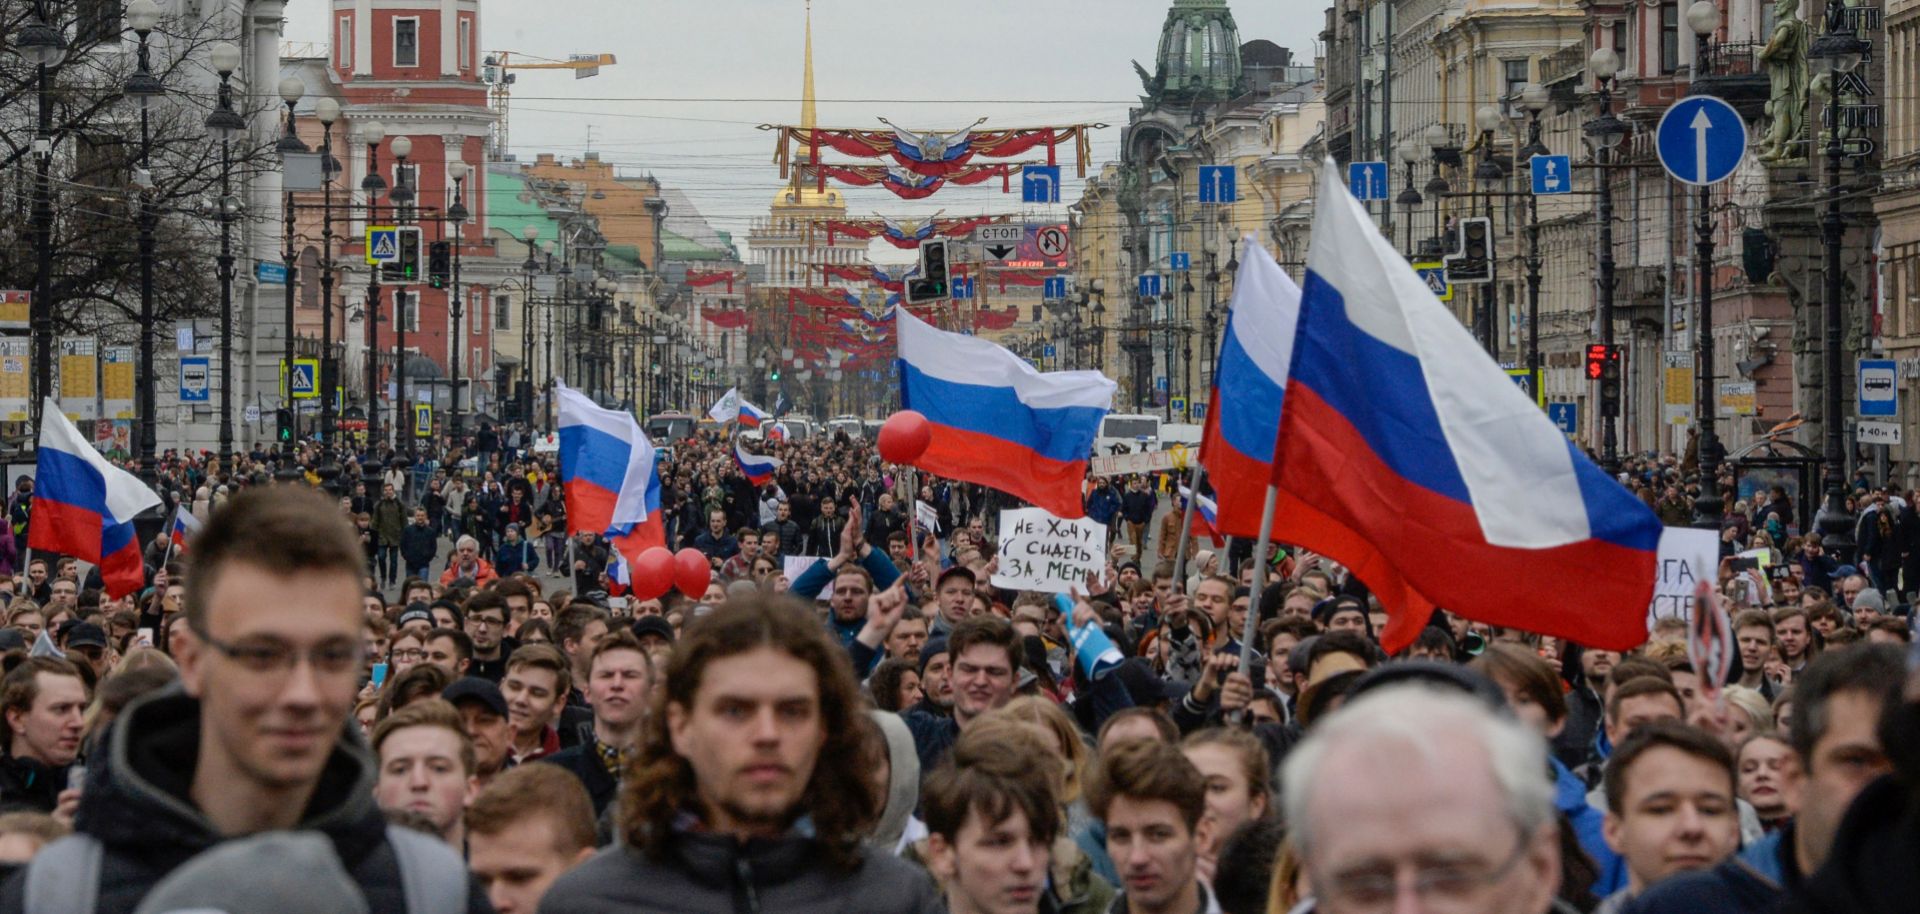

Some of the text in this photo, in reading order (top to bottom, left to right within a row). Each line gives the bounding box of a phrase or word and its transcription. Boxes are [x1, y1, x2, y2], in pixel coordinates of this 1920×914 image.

[982, 228, 1018, 239] СТОП
[1868, 428, 1880, 436] 40
[1014, 518, 1034, 536] НЕ
[1009, 558, 1034, 578] ЗА
[1655, 558, 1696, 585] ГА
